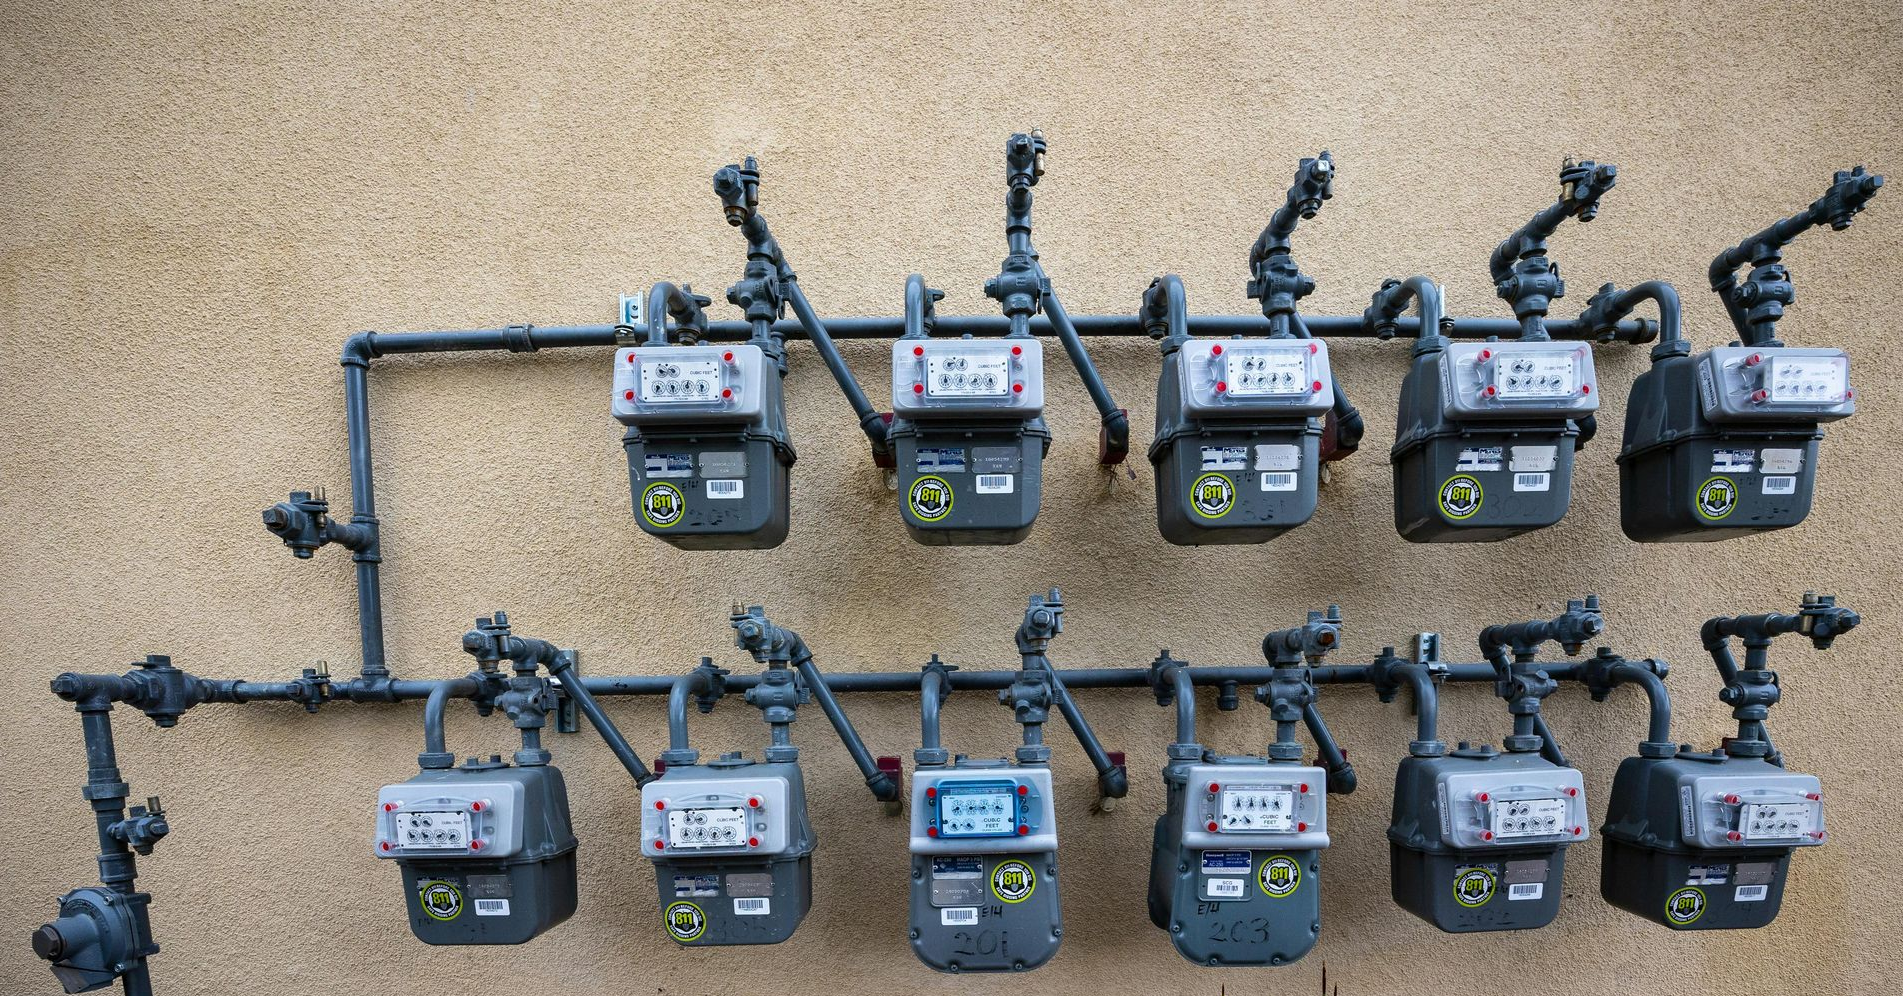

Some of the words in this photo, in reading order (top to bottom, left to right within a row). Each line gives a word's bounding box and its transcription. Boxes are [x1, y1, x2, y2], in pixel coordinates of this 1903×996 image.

[912, 482, 924, 496] CONTACT
[1194, 480, 1204, 496] CONTACT
[1204, 486, 1221, 499] 811
[1443, 481, 1454, 496] CONTACT
[1452, 487, 1470, 500] 811
[645, 489, 653, 504] CONTACT
[922, 488, 940, 502] 811
[1709, 489, 1726, 501] 811
[653, 495, 671, 508] 811
[1217, 501, 1230, 513] PARTNER
[933, 506, 947, 517] PARTNER
[1463, 504, 1477, 515] PARTNER
[668, 510, 680, 523] PARTNER
[995, 867, 1004, 882] CONTACT
[1262, 862, 1272, 876] CONTACT
[1271, 868, 1288, 880] 811
[1004, 873, 1022, 885] 811
[1283, 882, 1296, 893] PARTNER
[1467, 880, 1482, 891] 811
[433, 893, 449, 903] 811
[1018, 886, 1031, 898] PARTNER
[1679, 898, 1694, 909] 811
[676, 913, 692, 924] 811
